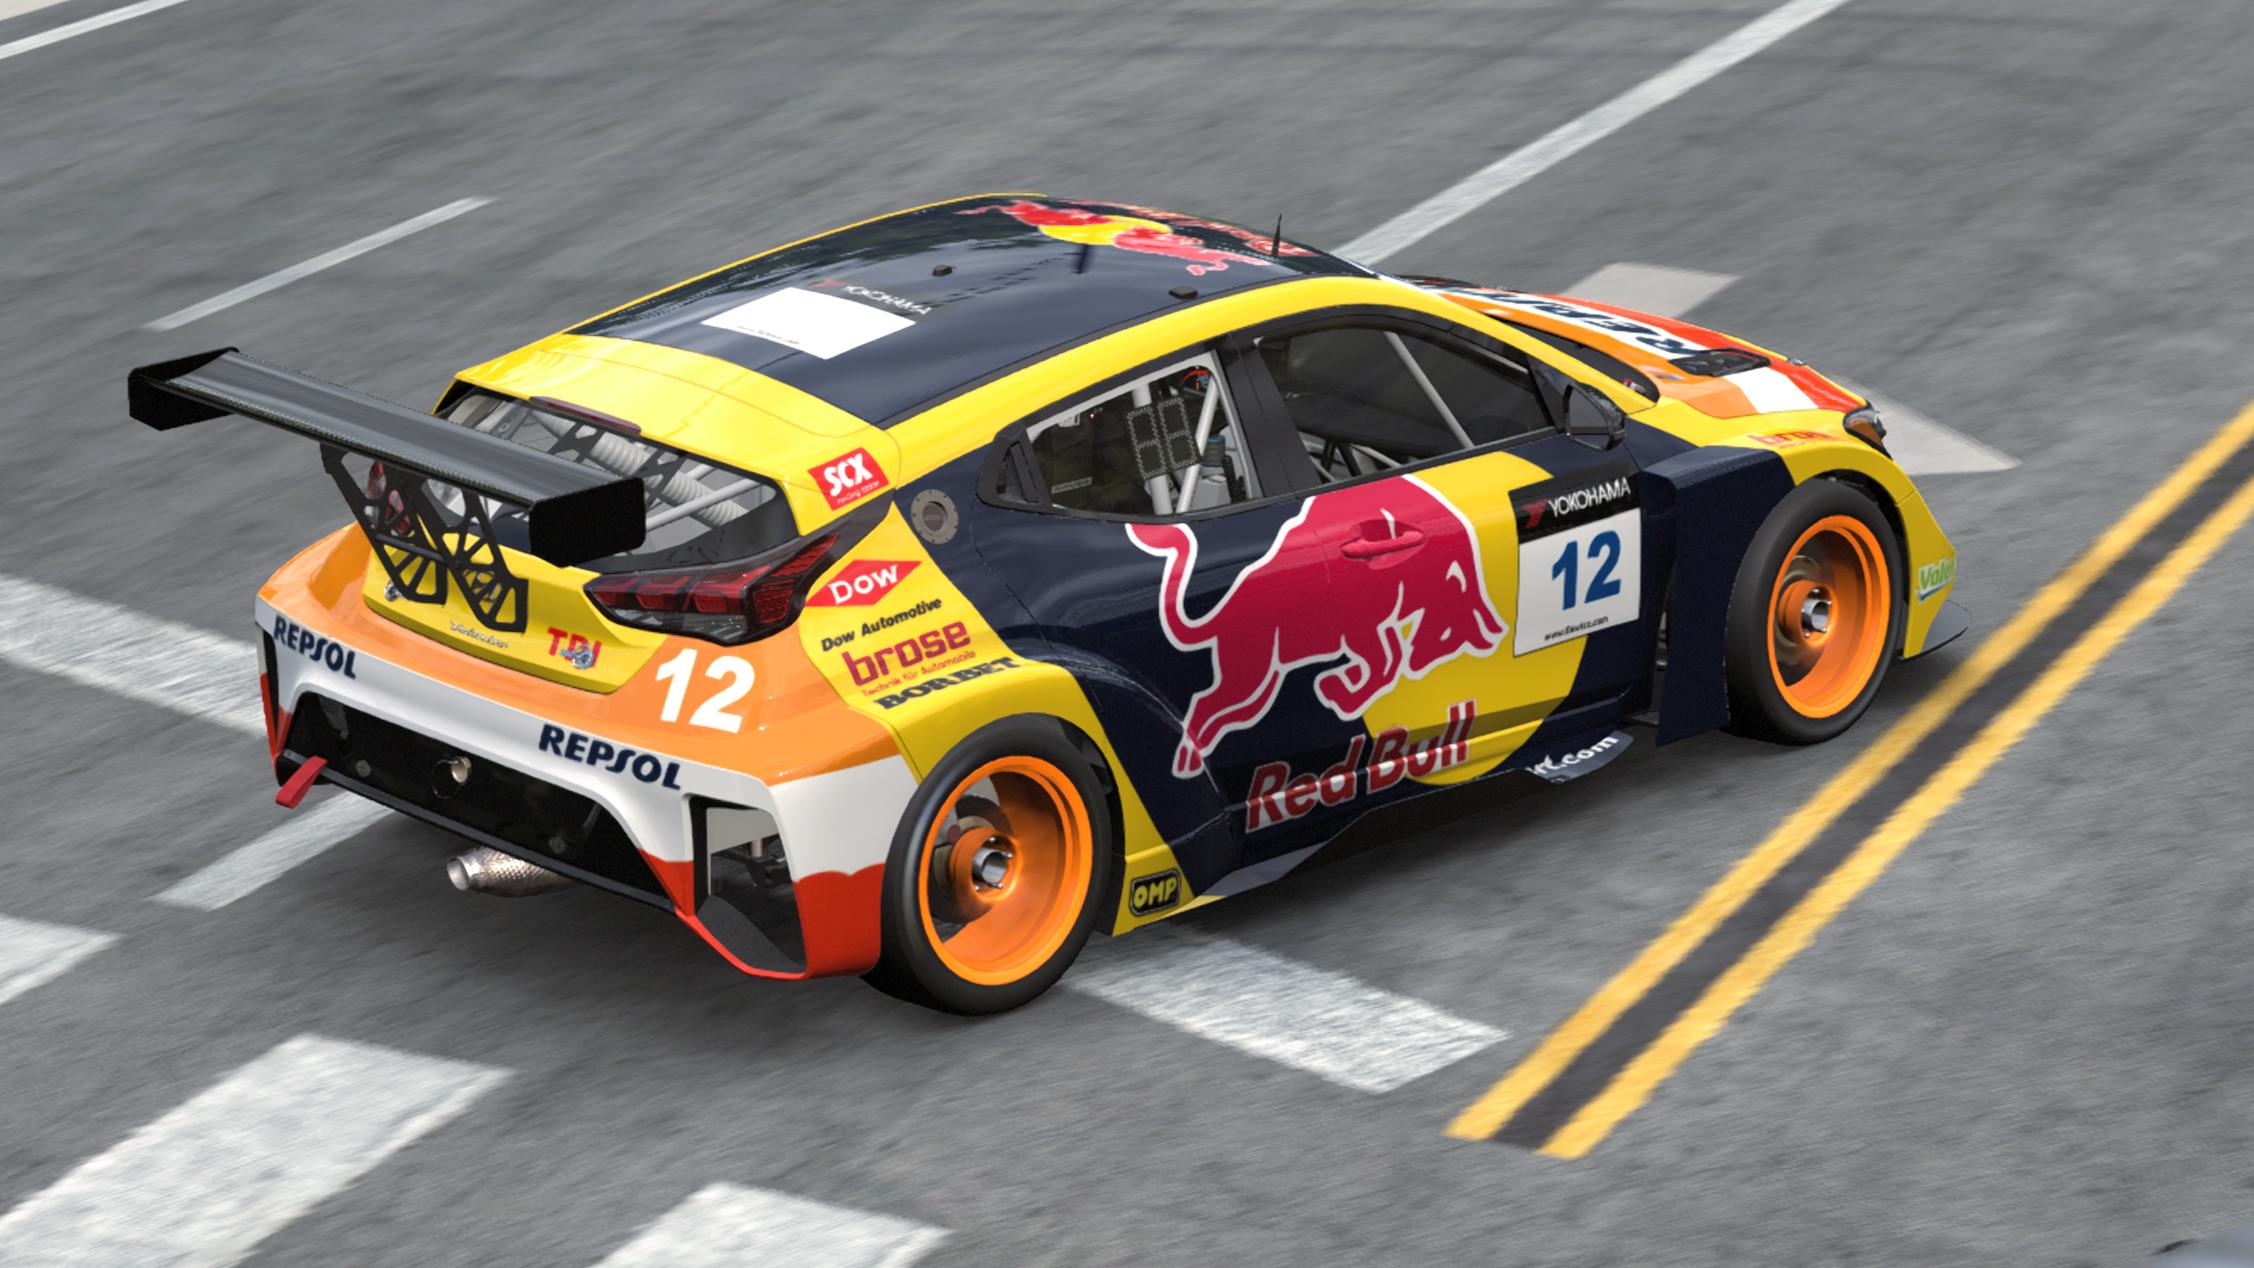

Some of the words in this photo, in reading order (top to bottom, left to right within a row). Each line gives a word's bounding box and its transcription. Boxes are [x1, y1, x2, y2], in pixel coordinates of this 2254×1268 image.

[823, 452, 873, 497] SCX
[1548, 476, 1631, 518] YOKOHAMA
[1552, 530, 1621, 611] 12
[273, 614, 357, 680] REPSOL
[821, 630, 855, 652] Dow
[861, 598, 943, 637] Automotive
[841, 620, 972, 687] brose
[655, 648, 756, 734] 12
[872, 656, 1020, 710] BORBET
[538, 722, 682, 791] REPSOL
[1246, 733, 1366, 834] Red
[1366, 697, 1478, 794] Bull
[1133, 876, 1178, 909] OMP
